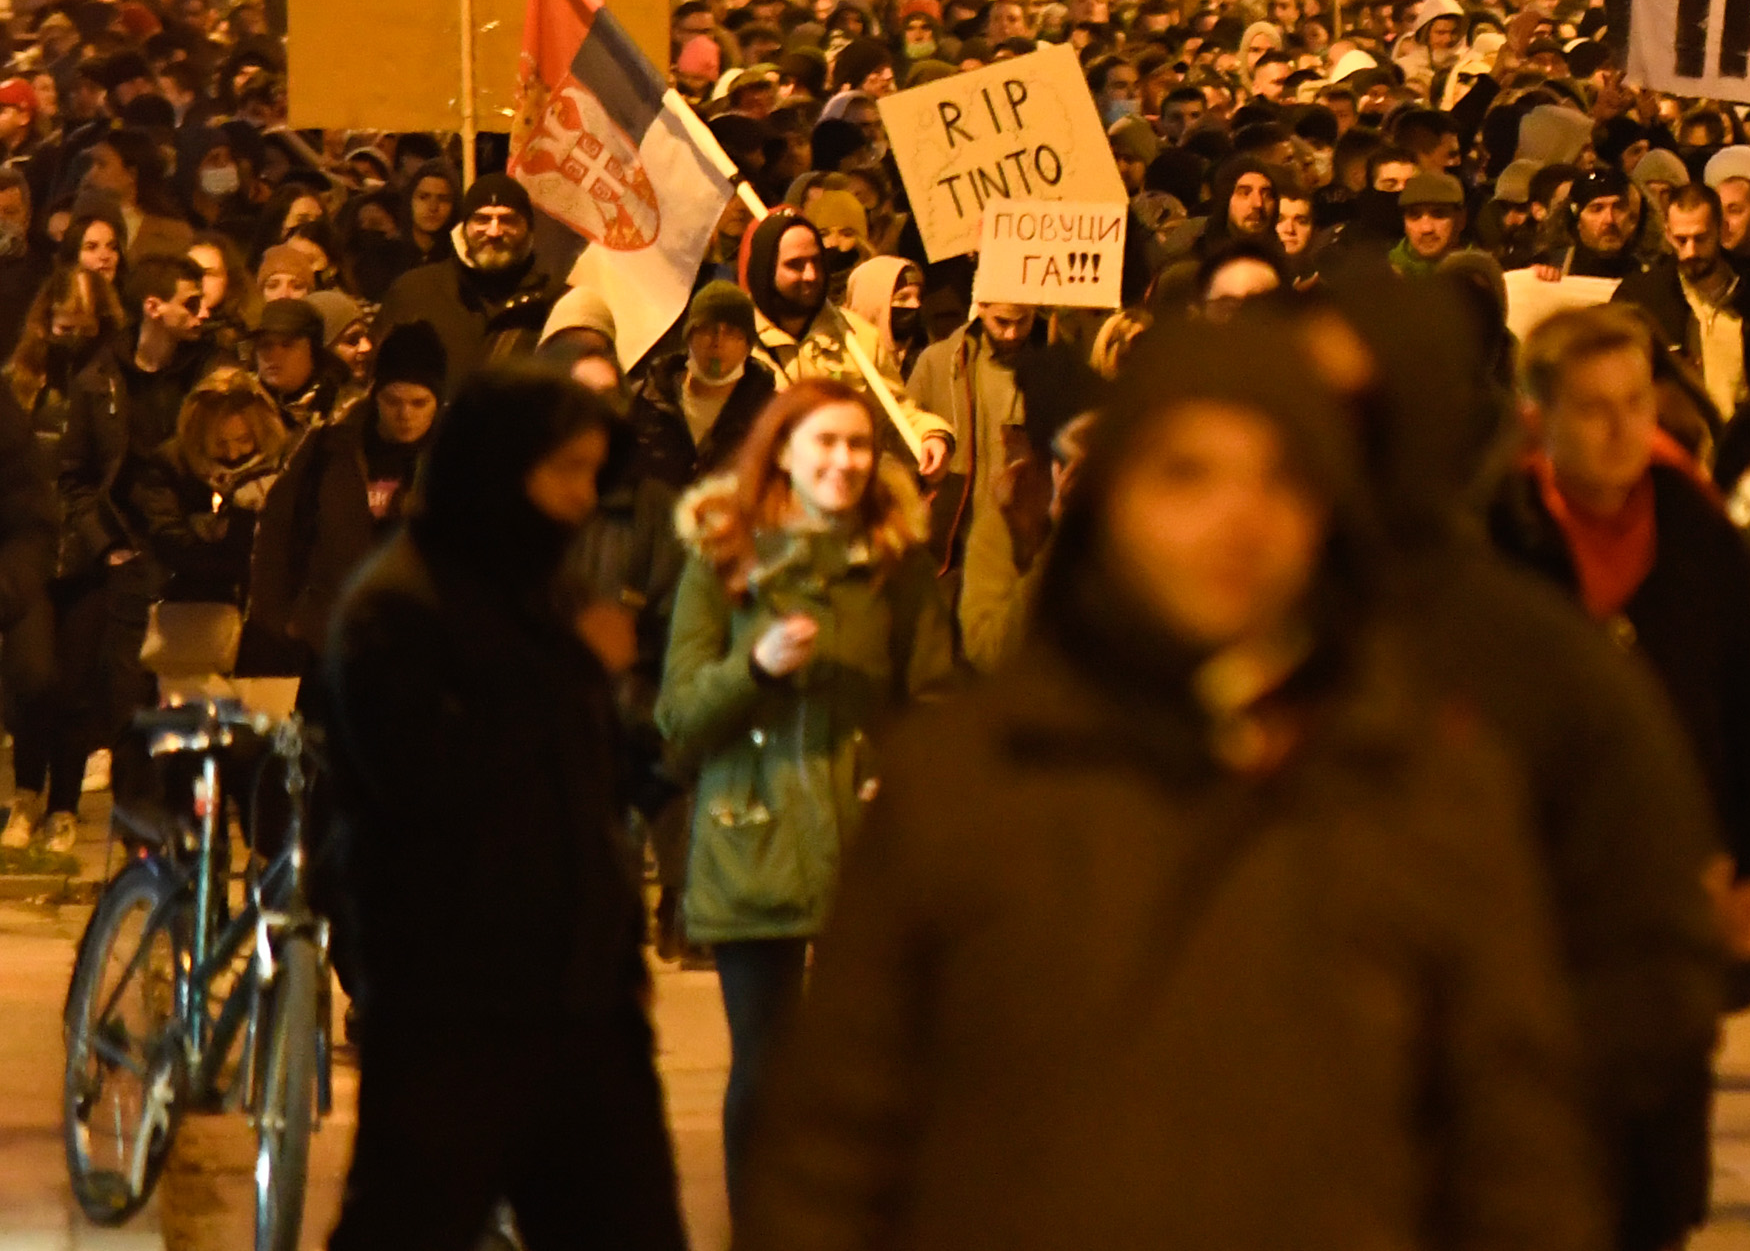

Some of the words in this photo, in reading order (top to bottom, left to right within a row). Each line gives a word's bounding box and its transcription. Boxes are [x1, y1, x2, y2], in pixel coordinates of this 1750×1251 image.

[937, 79, 1028, 149] RIP
[936, 144, 1063, 219] TINTO
[993, 213, 1122, 244] ПОВУЦИ
[1021, 252, 1102, 286] ГА!!!
